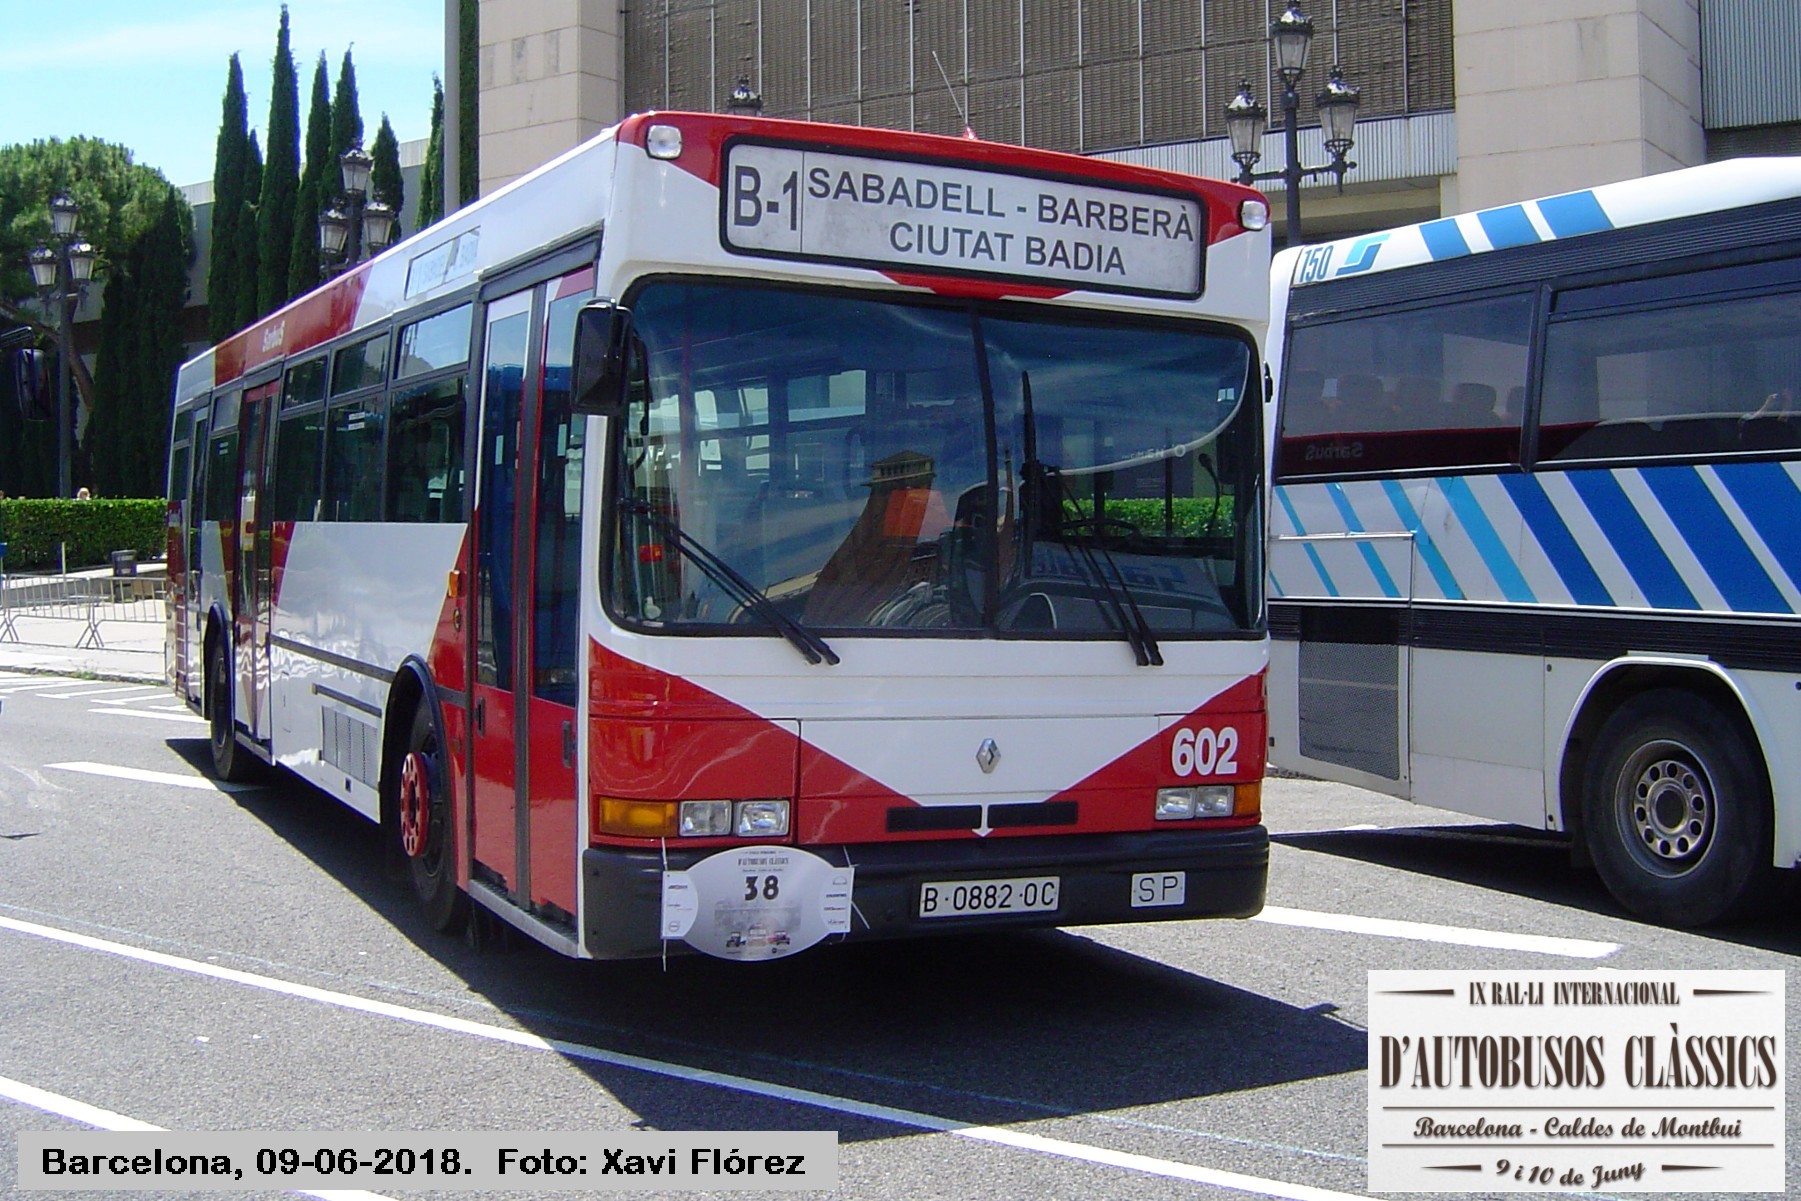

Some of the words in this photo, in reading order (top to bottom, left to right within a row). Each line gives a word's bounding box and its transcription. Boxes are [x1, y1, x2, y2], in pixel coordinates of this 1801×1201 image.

[733, 164, 798, 232] B-1
[807, 167, 1005, 219] SABADELL
[1037, 194, 1195, 242] BARBERÀ
[889, 221, 1014, 262] CIUTAT
[1025, 236, 1126, 275] BADIA
[1300, 245, 1332, 282] 150
[1171, 726, 1239, 777] 602
[744, 875, 779, 901] 38
